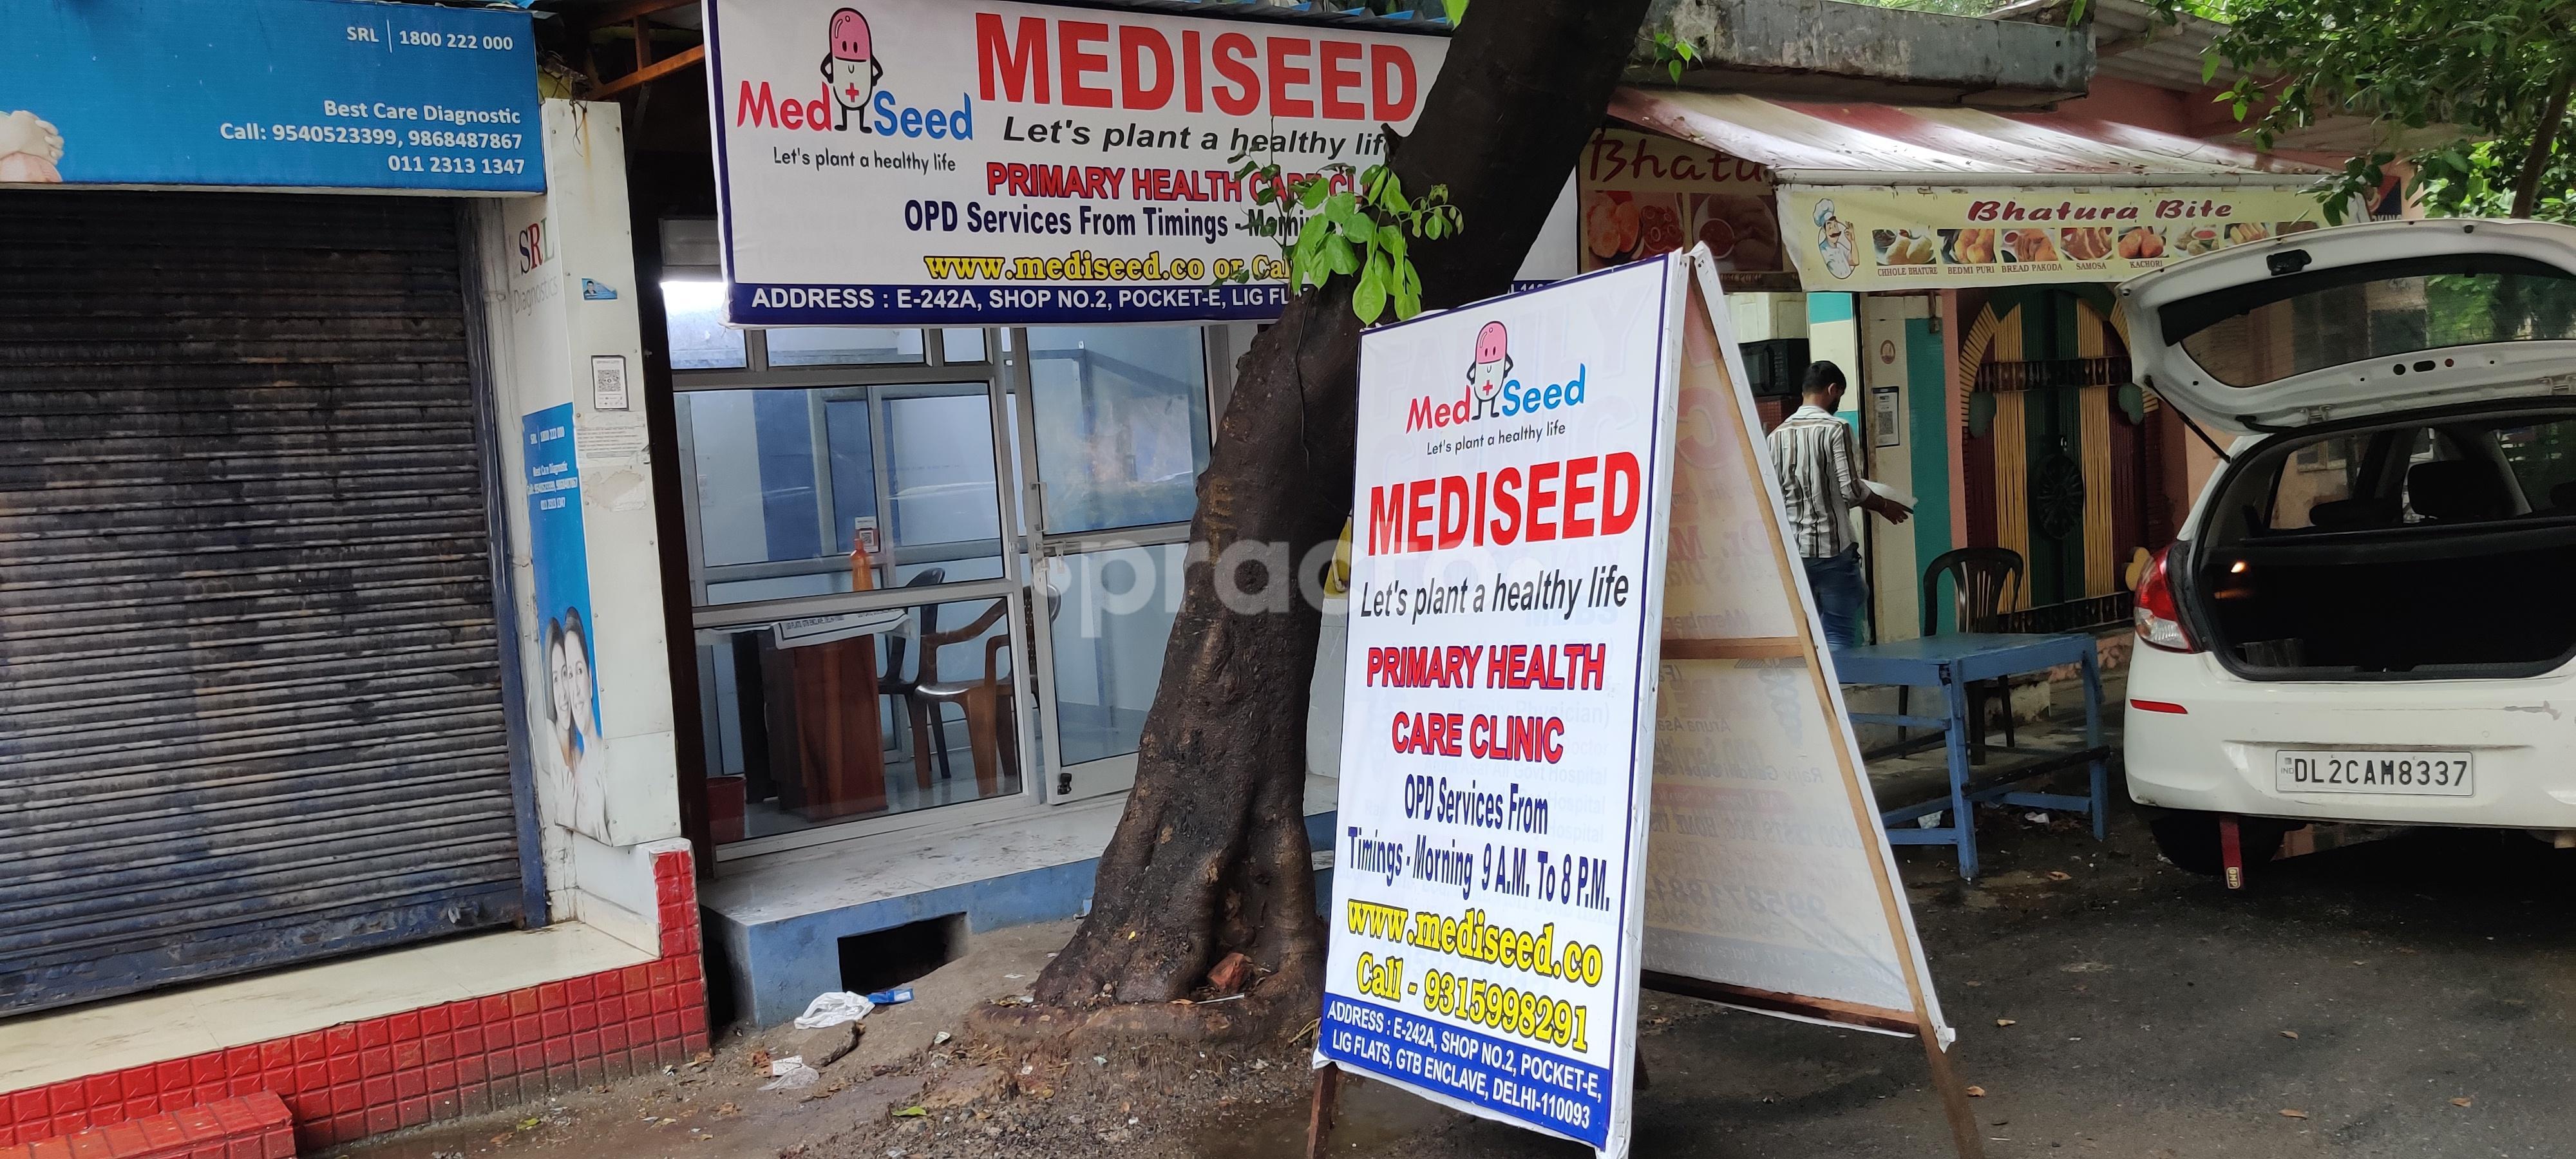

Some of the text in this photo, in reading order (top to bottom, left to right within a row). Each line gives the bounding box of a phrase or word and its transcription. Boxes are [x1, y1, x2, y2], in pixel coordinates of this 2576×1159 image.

[346, 26, 513, 51] SRL 1800 222 000
[975, 12, 1417, 122] MEDISEED
[324, 100, 521, 126] Best Care Diagnostic
[737, 80, 973, 141] Med Seed
[220, 122, 522, 149] Call: 9540523399, 9868487867
[1003, 116, 1091, 145] Let's
[1103, 122, 1192, 153] plant
[1201, 133, 1218, 150] a
[1231, 127, 1346, 160] healthy
[388, 155, 525, 174] 011 2313 1347
[773, 146, 956, 176] Let's plant a healthy life
[986, 162, 1126, 200] PRIMARY
[1131, 168, 1242, 202] HEALTH
[905, 199, 958, 232] OPD
[967, 202, 1072, 235] Services
[1079, 205, 1136, 236] From
[1142, 207, 1229, 245] Timings
[1967, 199, 2233, 221] Bhatura Bite
[519, 217, 555, 275] SRL
[923, 250, 1206, 281] www.mediseed.co
[1251, 254, 1290, 281] Cal
[2076, 261, 2107, 270] SAMOSA
[2130, 260, 2163, 269] KACHORI
[1877, 266, 1938, 277] CHHOLE BHATURE
[1947, 265, 1995, 275] BEDMI PURI
[2002, 263, 2062, 273] BREAD PAKODA
[513, 275, 559, 316] Diagnostics
[752, 288, 875, 308] ADDRESS
[897, 289, 982, 311] E-242A,
[989, 290, 1051, 308] SHOP
[1058, 290, 1113, 310] NO.2,
[1119, 288, 1226, 309] POCKET-E,
[1232, 288, 1263, 306] LIG
[1406, 363, 1586, 434] Med Seed
[1426, 419, 1566, 455] Let's plant a healthy life
[1367, 451, 1641, 557] MEDISEED
[1360, 563, 1629, 625] Let's plant a healthy life
[1367, 643, 1606, 691] PRIMARY HEALTH
[1392, 711, 1565, 764] CARE CLINIC
[2295, 758, 2467, 787] DL2CAM8337
[1405, 774, 1548, 835] OPD Services From
[1347, 826, 1403, 887] Timings
[1412, 834, 1473, 901] Morning
[1481, 843, 1492, 892] 9
[1495, 845, 1530, 898] A.M.
[1537, 851, 1555, 904] To
[1561, 854, 1572, 905] 8
[1577, 856, 1611, 912] P.M.
[1347, 898, 1603, 988] www.mediseed.co
[1356, 951, 1404, 1003] Call
[1423, 968, 1589, 1053] 9315998291
[1327, 1000, 1384, 1034] ADDRESS
[1394, 1019, 1437, 1053] E-242A,
[1441, 1031, 1479, 1061] SHOP
[1482, 1043, 1517, 1077] NO.2,
[1520, 1053, 1602, 1104] POCKET-E,
[1332, 1028, 1590, 1129] LIG FLATS, GTB ENCLAVE, DELHI-110093
